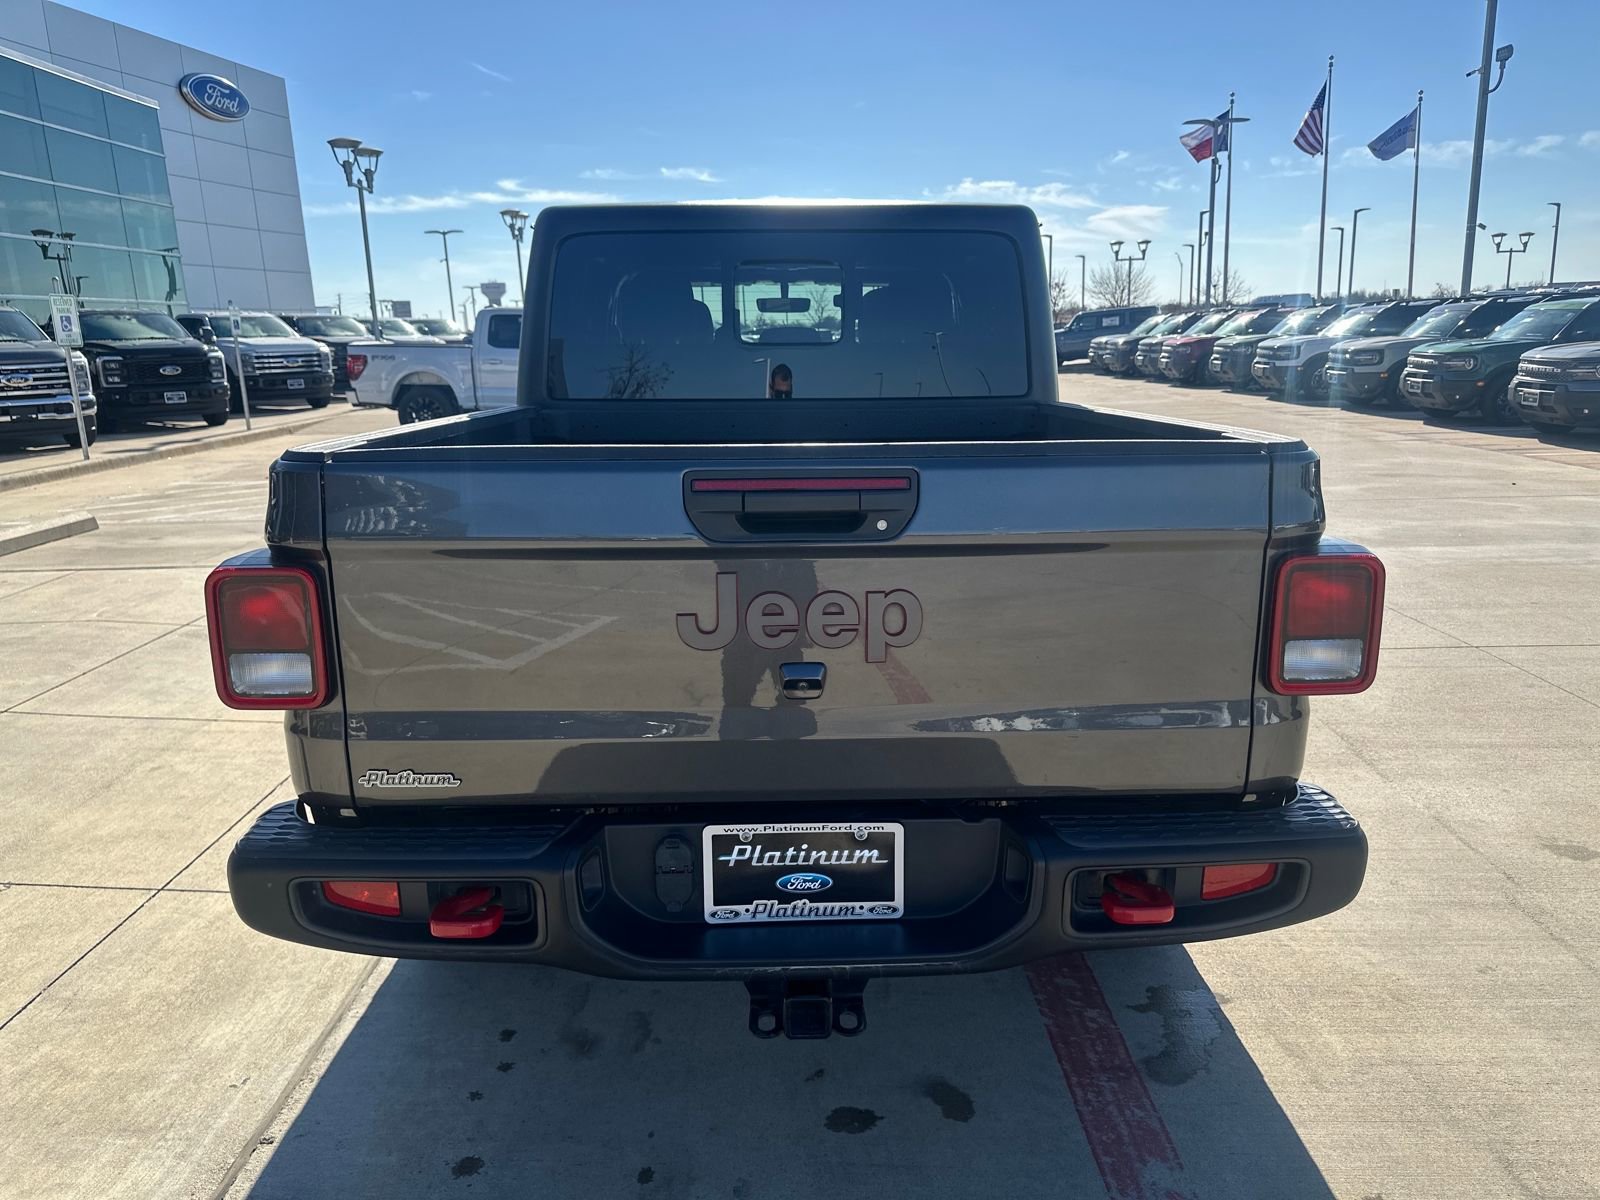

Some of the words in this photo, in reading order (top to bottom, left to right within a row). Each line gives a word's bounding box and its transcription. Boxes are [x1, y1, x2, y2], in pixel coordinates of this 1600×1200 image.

[204, 83, 239, 113] Ford
[676, 571, 923, 663] Jeep
[359, 770, 461, 788] Platinum
[723, 825, 885, 833] www.PlatinumFord.com
[717, 844, 889, 867] Platinum
[787, 876, 822, 890] Ford
[751, 901, 865, 918] Platinum
